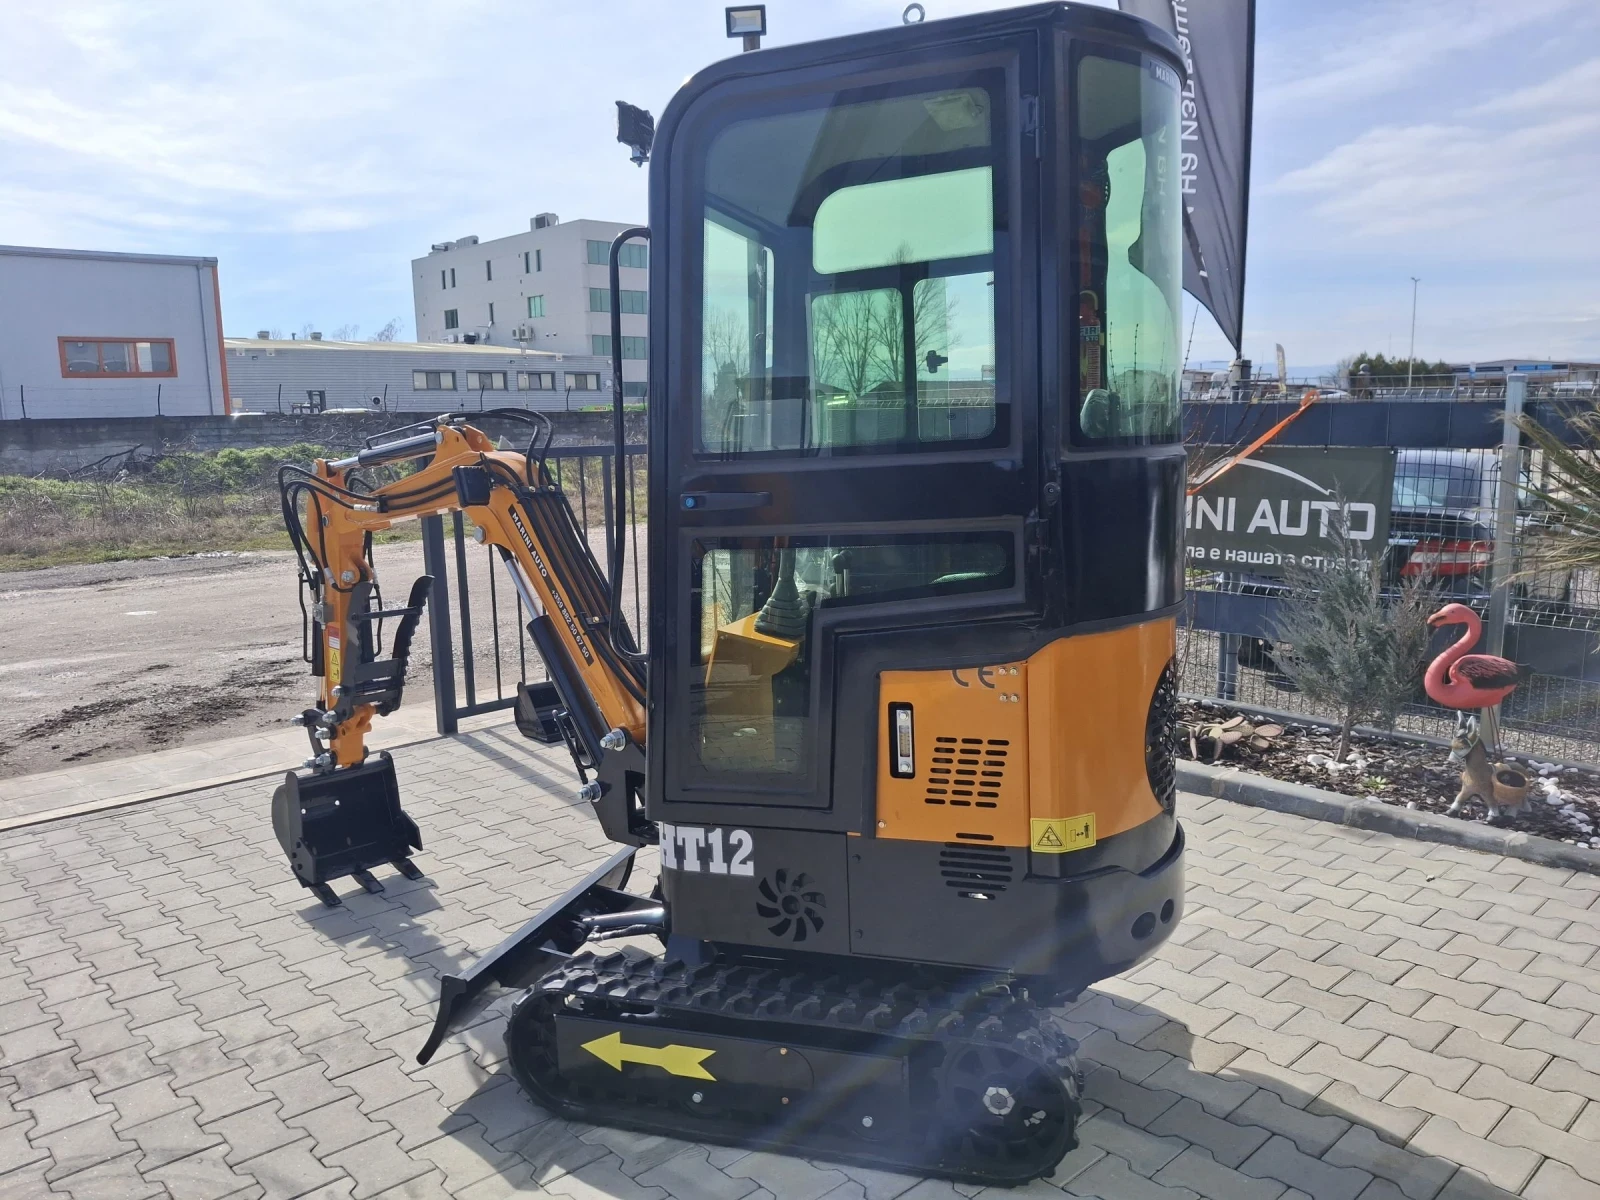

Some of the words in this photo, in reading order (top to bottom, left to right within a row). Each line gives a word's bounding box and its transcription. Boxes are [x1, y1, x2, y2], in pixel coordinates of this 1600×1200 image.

[1247, 498, 1376, 541] AUTO
[512, 512, 533, 549] MARINI
[531, 550, 548, 577] AUTO
[552, 589, 564, 609] +359
[658, 821, 755, 876] HT12
